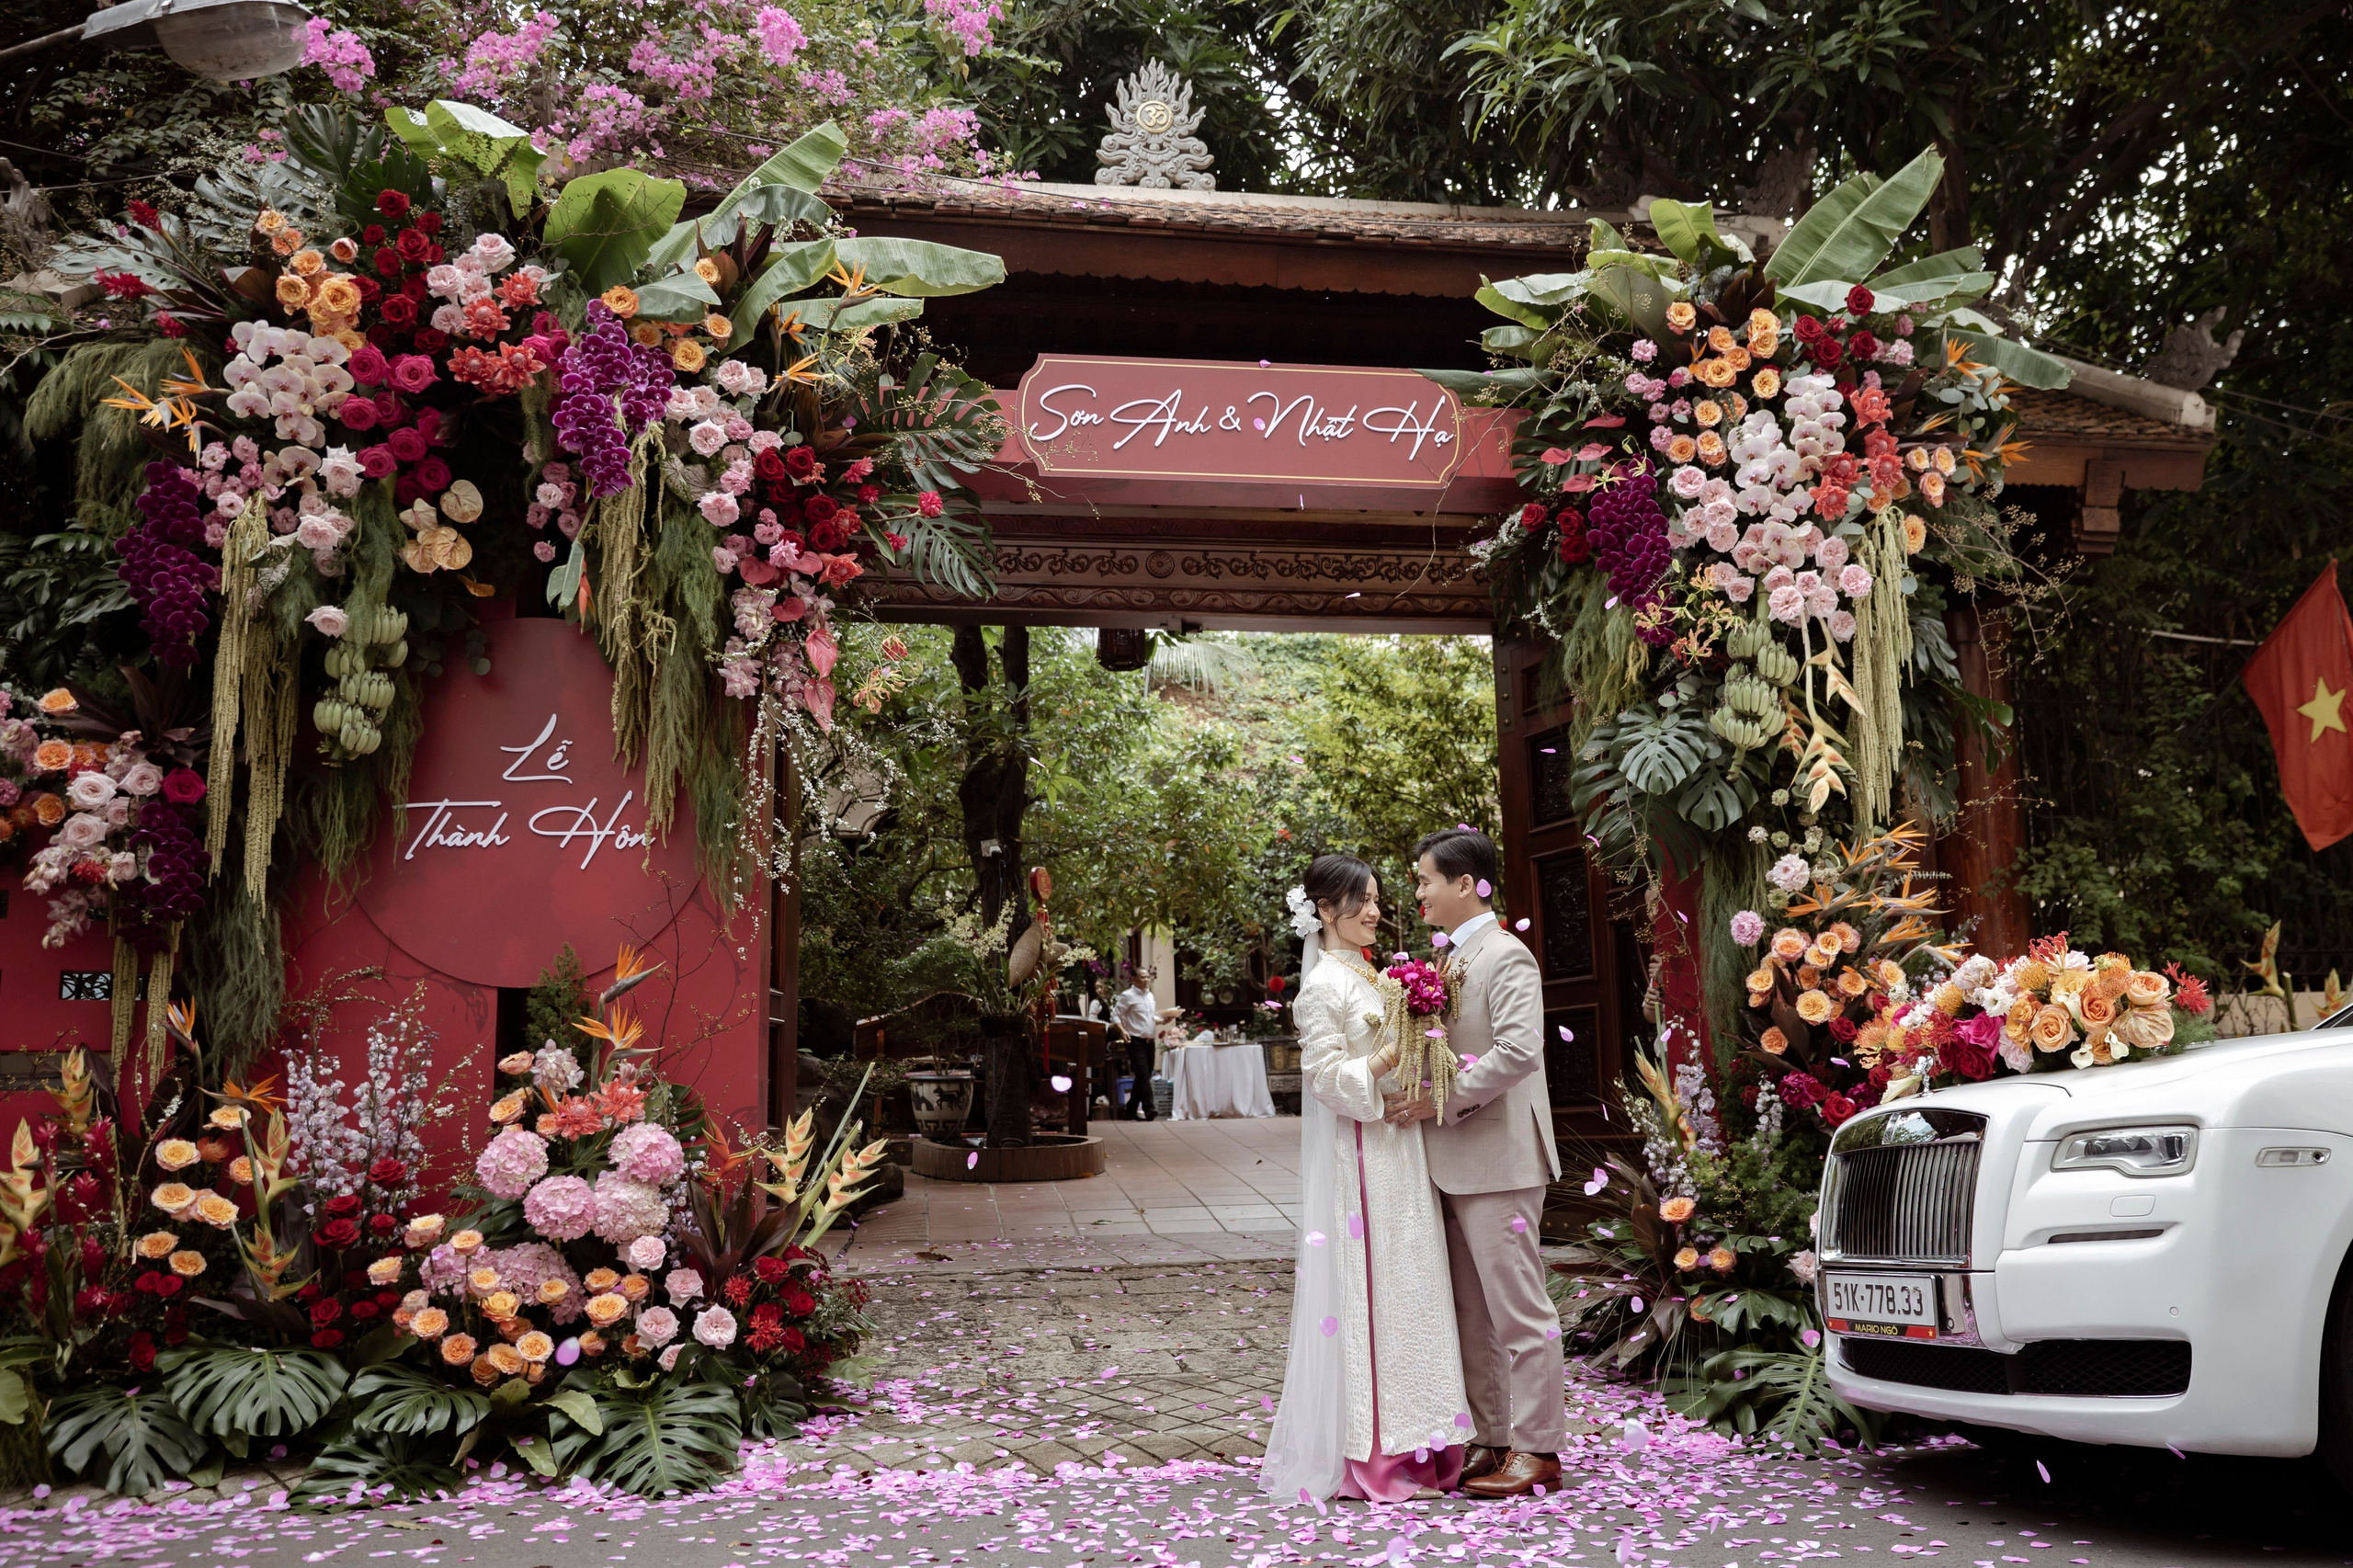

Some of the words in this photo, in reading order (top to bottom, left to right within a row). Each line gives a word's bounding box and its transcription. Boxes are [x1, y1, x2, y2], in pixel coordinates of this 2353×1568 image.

[1029, 383, 1104, 441] Sơn
[1109, 389, 1211, 449] Anh
[1219, 405, 1242, 431] &
[1247, 392, 1358, 447] Nhật
[1362, 395, 1454, 461] Hạ
[500, 713, 574, 784] Lễ
[392, 798, 510, 860] Thành
[529, 790, 656, 870] Hôn
[1834, 1282, 1924, 1316] 51K-778.33
[1855, 1324, 1879, 1334] MARIO
[1881, 1325, 1898, 1335] NGÔ
